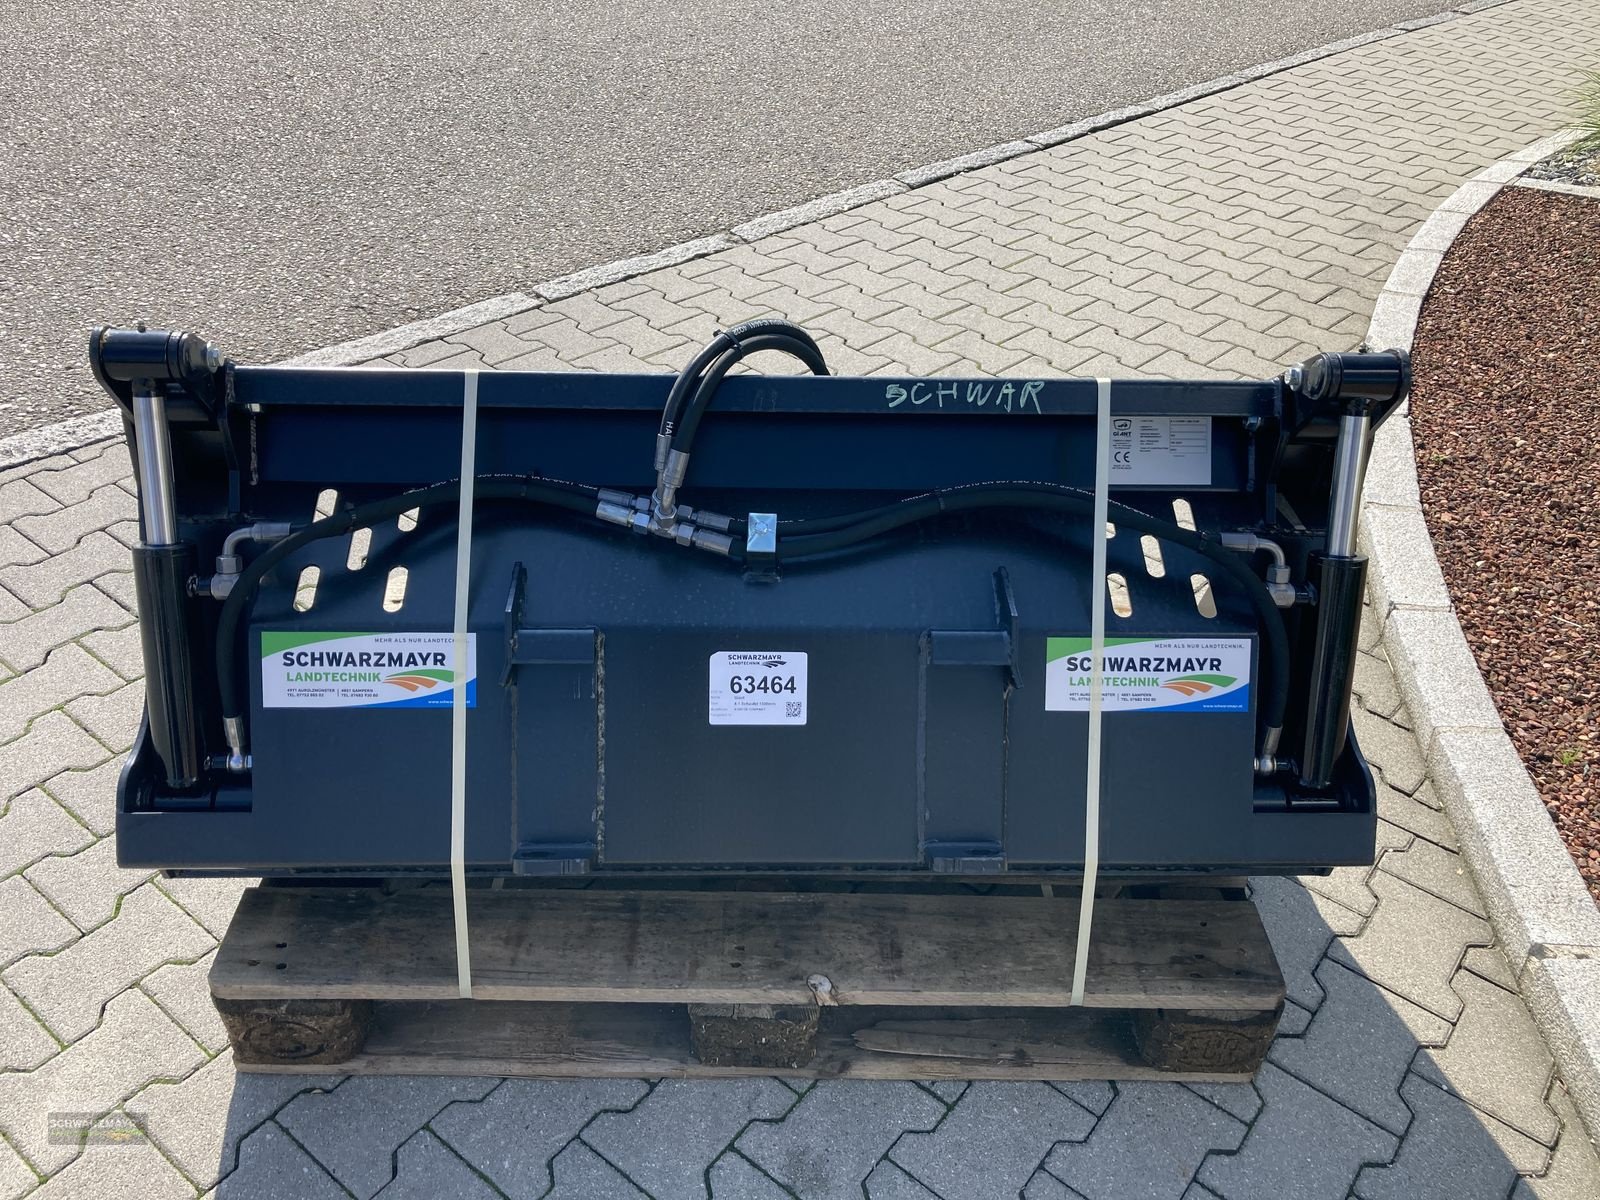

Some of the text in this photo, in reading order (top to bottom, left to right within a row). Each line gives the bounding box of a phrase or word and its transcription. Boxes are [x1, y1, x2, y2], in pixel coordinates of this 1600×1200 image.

[885, 381, 1045, 414] SCHWAR
[282, 651, 446, 667] SCHWARZMAYR
[286, 672, 381, 682] LANDTECHNIK
[730, 675, 797, 694] 63464
